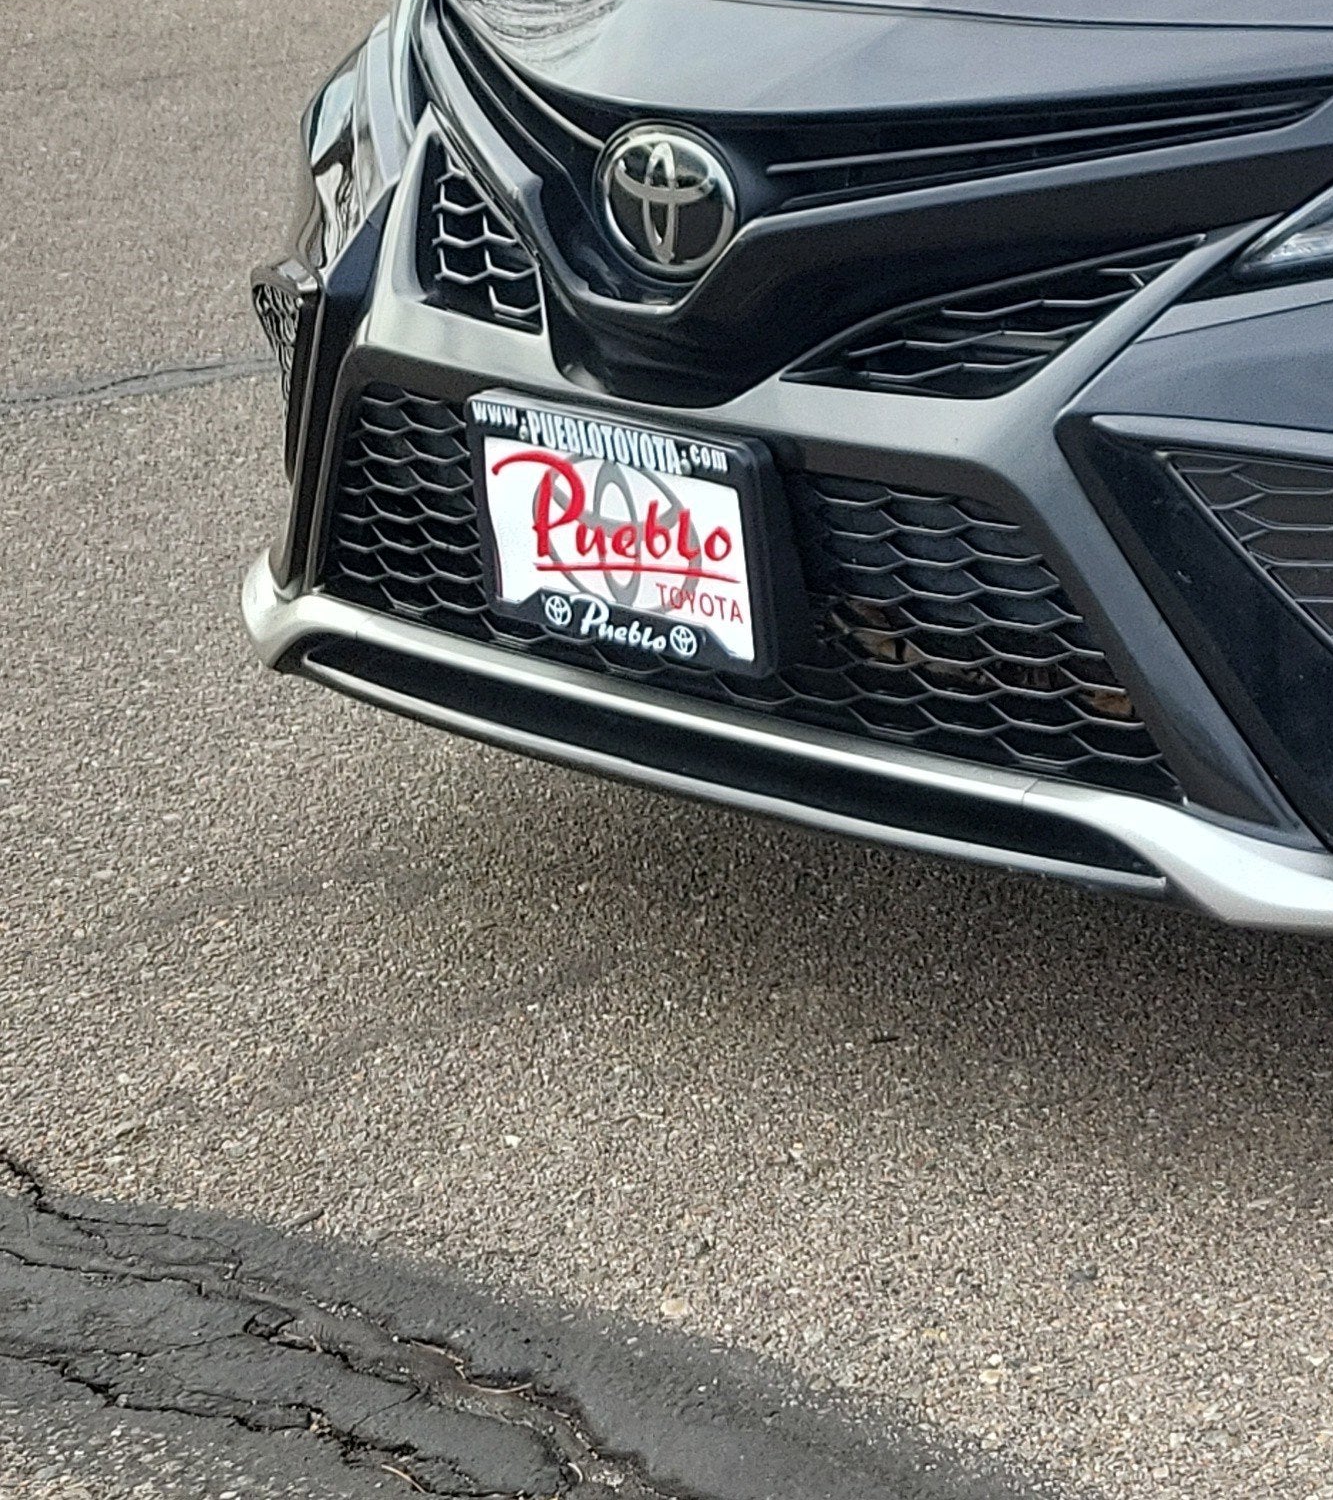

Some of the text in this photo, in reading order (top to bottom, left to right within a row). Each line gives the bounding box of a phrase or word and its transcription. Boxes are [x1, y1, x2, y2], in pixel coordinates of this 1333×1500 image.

[491, 450, 731, 561] Pueblo
[569, 593, 667, 652] Pueblo
[655, 582, 744, 624] TOYOTA
